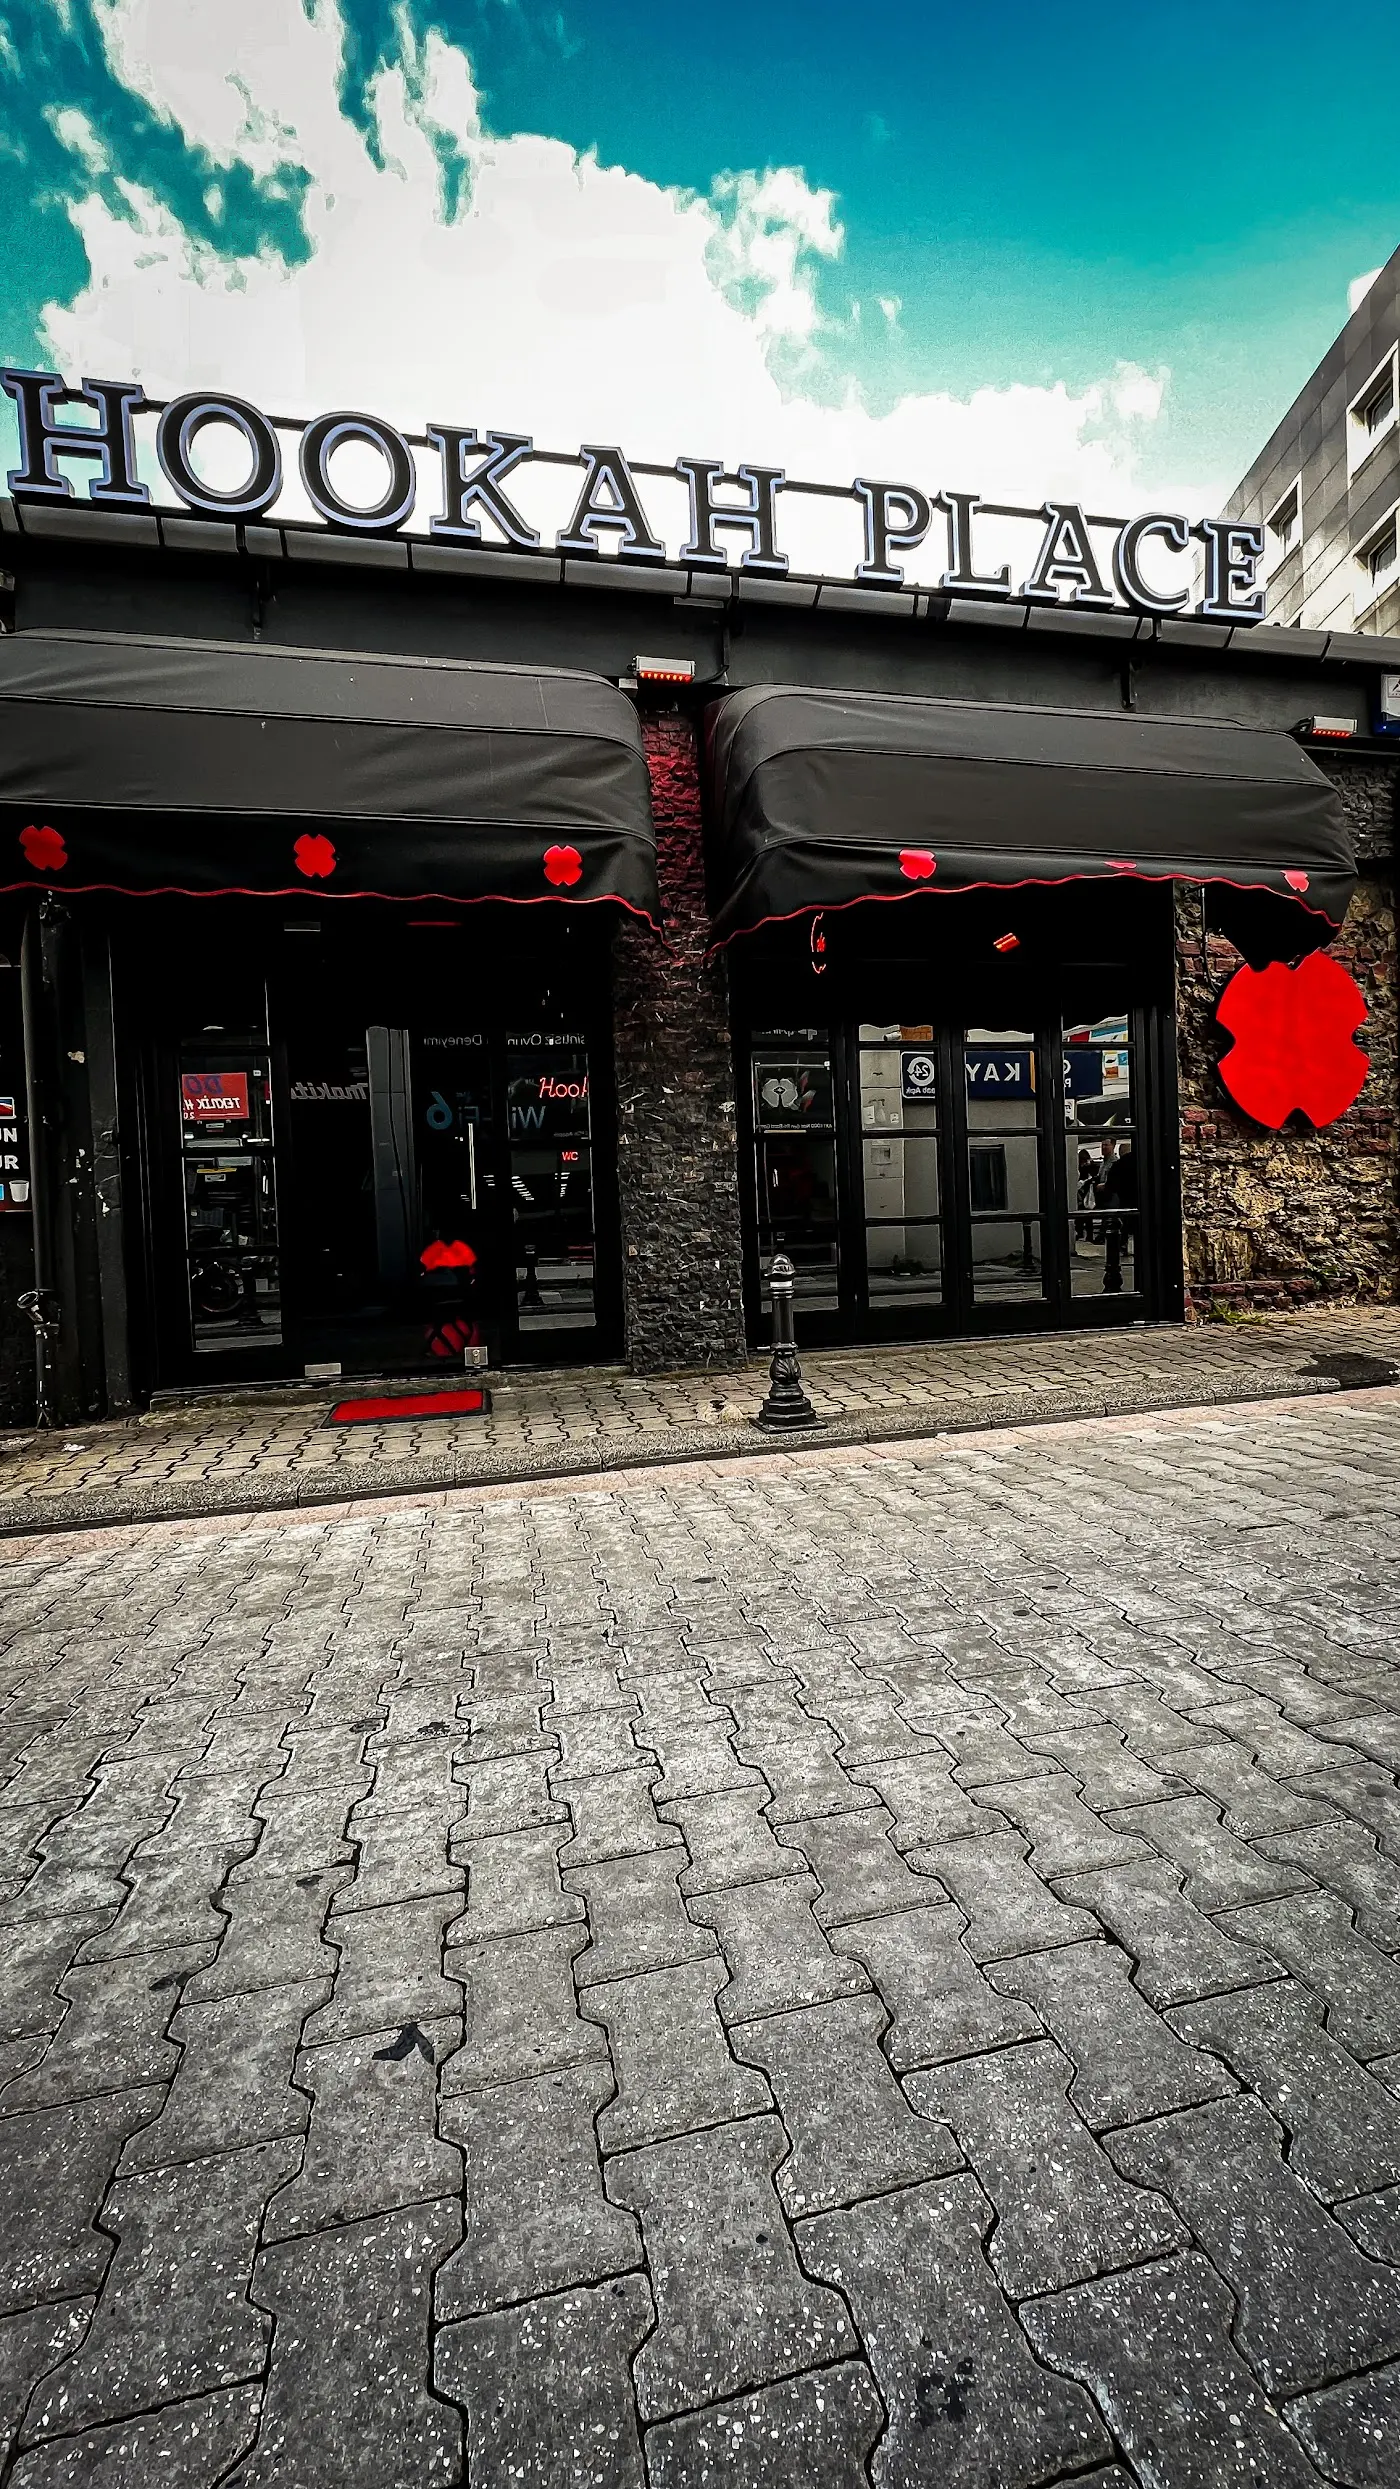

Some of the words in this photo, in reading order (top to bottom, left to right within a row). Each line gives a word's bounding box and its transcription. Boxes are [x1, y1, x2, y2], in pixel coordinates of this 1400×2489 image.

[0, 367, 788, 573] HOOKAH
[853, 478, 1266, 621] PLACE
[561, 1151, 580, 1161] WC
